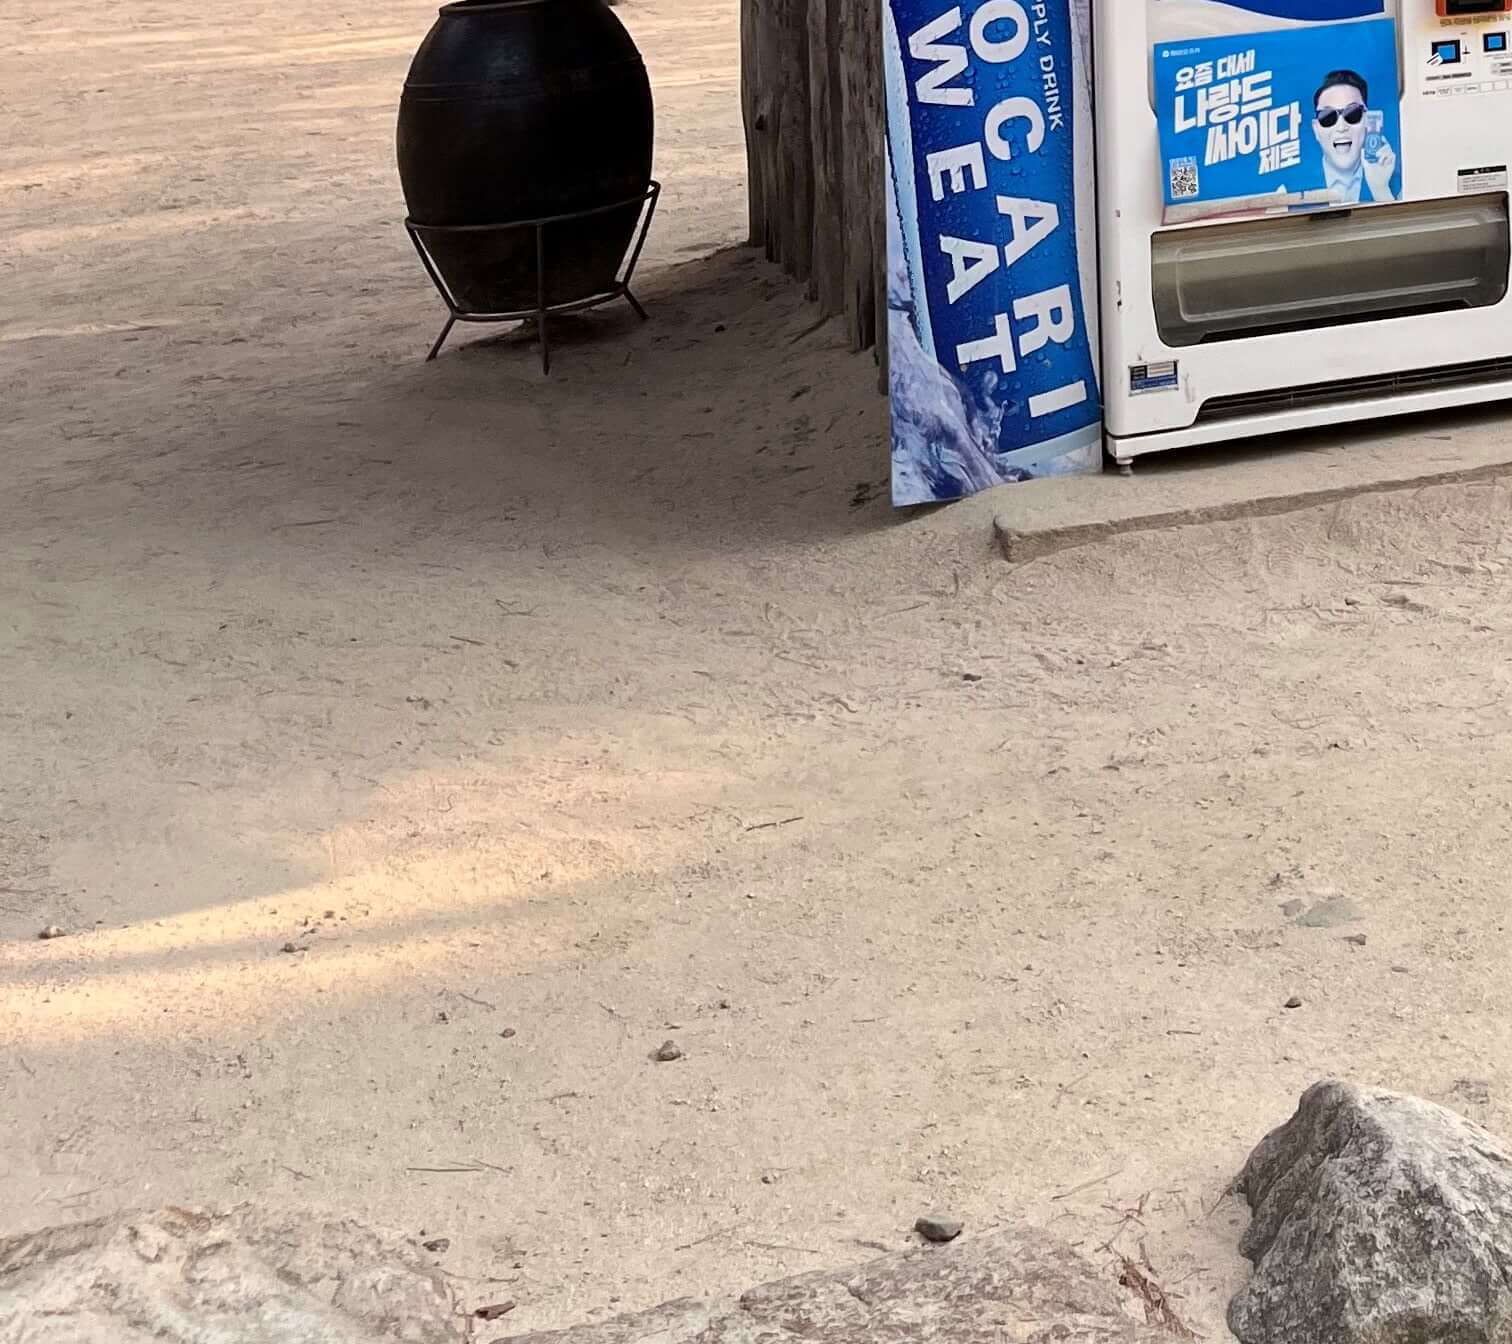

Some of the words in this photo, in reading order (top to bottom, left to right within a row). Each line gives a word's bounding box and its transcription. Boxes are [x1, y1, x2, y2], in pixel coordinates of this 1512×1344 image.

[1040, 56, 1065, 130] DRINK
[1175, 60, 1213, 92] 요즘
[1216, 49, 1256, 78] 대세
[1174, 70, 1273, 134] 나랑드
[1258, 139, 1301, 175] 제로
